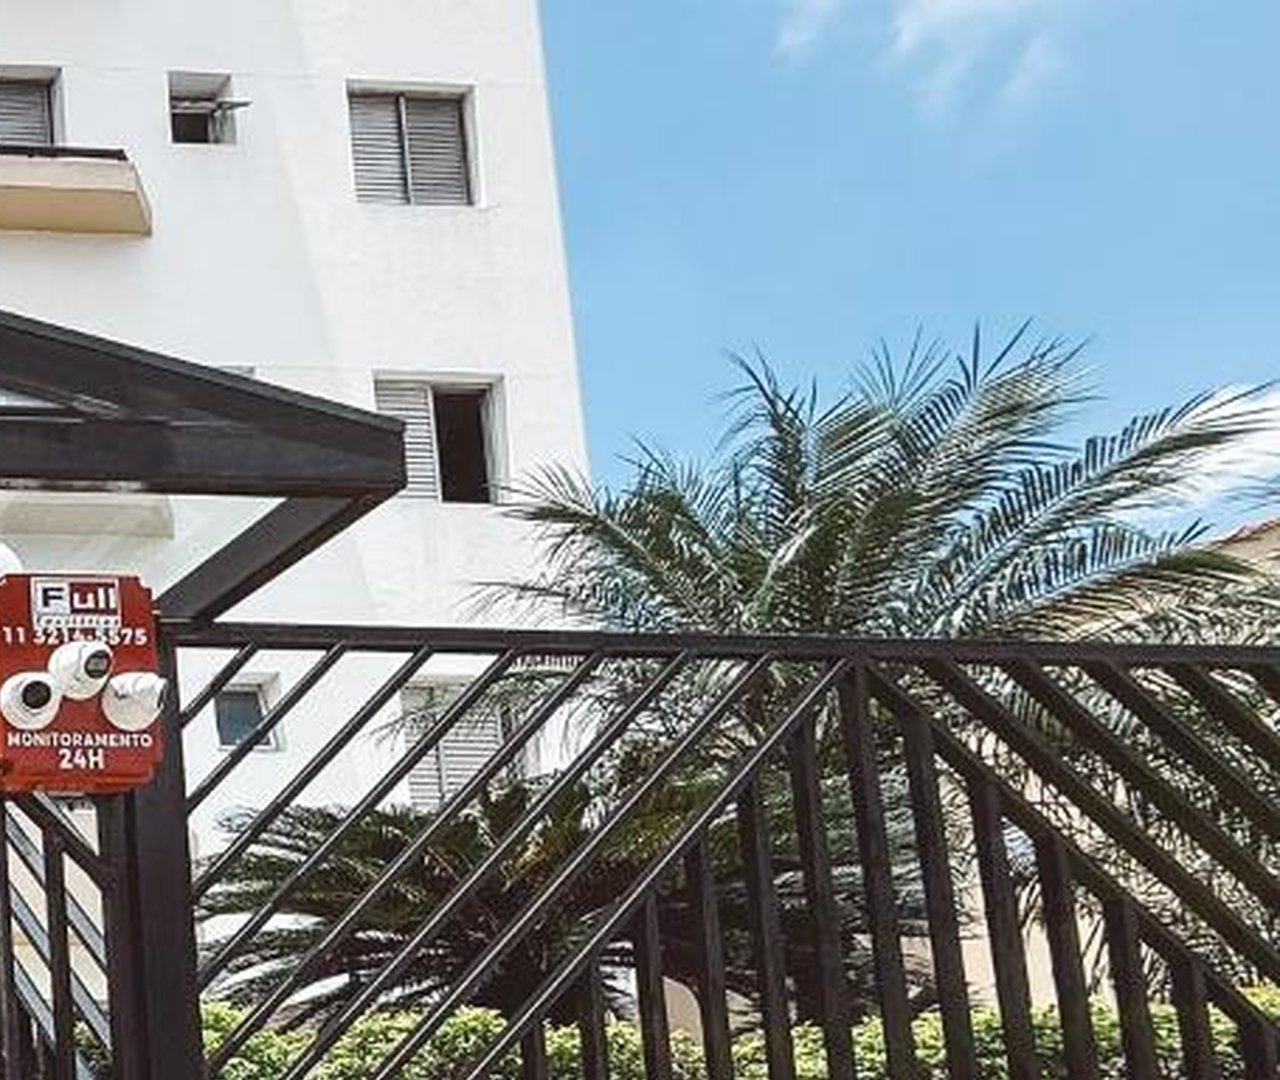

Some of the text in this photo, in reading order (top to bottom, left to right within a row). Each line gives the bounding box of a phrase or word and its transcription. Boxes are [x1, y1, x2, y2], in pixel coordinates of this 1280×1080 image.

[42, 586, 116, 610] Full
[2, 626, 26, 645] 11
[7, 732, 153, 748] MONITORAMENTO
[58, 749, 105, 769] 24H
